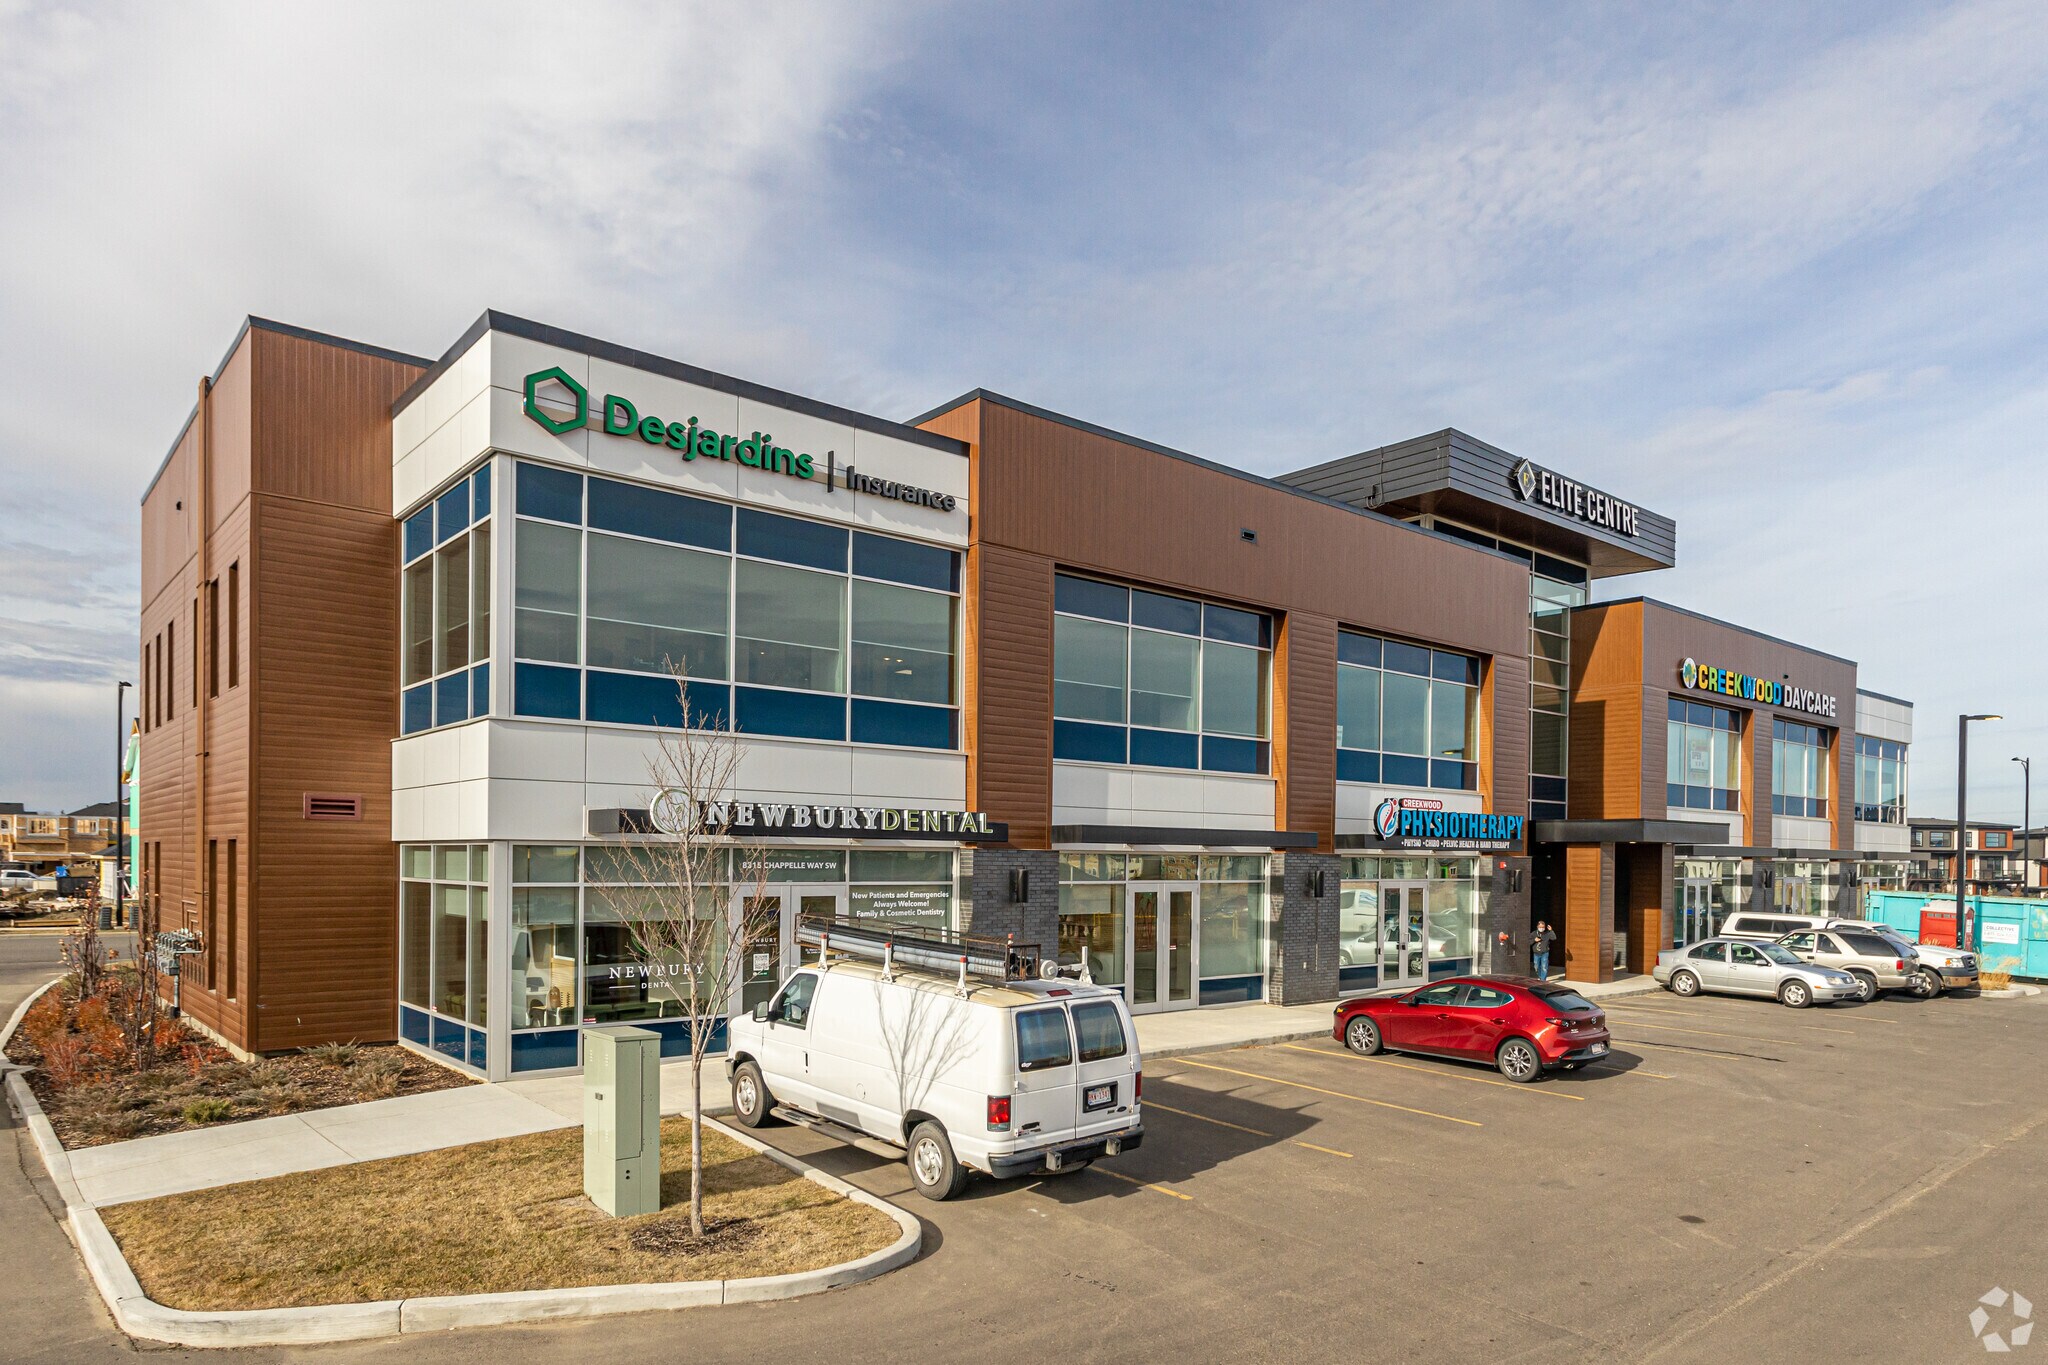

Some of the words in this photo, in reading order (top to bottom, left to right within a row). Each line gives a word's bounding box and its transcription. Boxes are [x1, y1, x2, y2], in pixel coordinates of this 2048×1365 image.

[603, 393, 815, 480] Desjardins
[846, 465, 956, 512] Insurance
[1541, 470, 1584, 516] ELITE
[1587, 490, 1640, 537] CENTRE
[1698, 664, 1782, 706] CREEKWOOD
[1784, 684, 1836, 718] DAYCARE
[1403, 799, 1441, 809] CREEKWOOD
[1401, 810, 1523, 839] PHYSIOTHERAPY
[1492, 841, 1510, 849] THERAPY
[910, 891, 949, 900] Emergencies
[873, 901, 897, 909] Always
[856, 910, 878, 918] Family
[641, 981, 673, 989] DENTA
